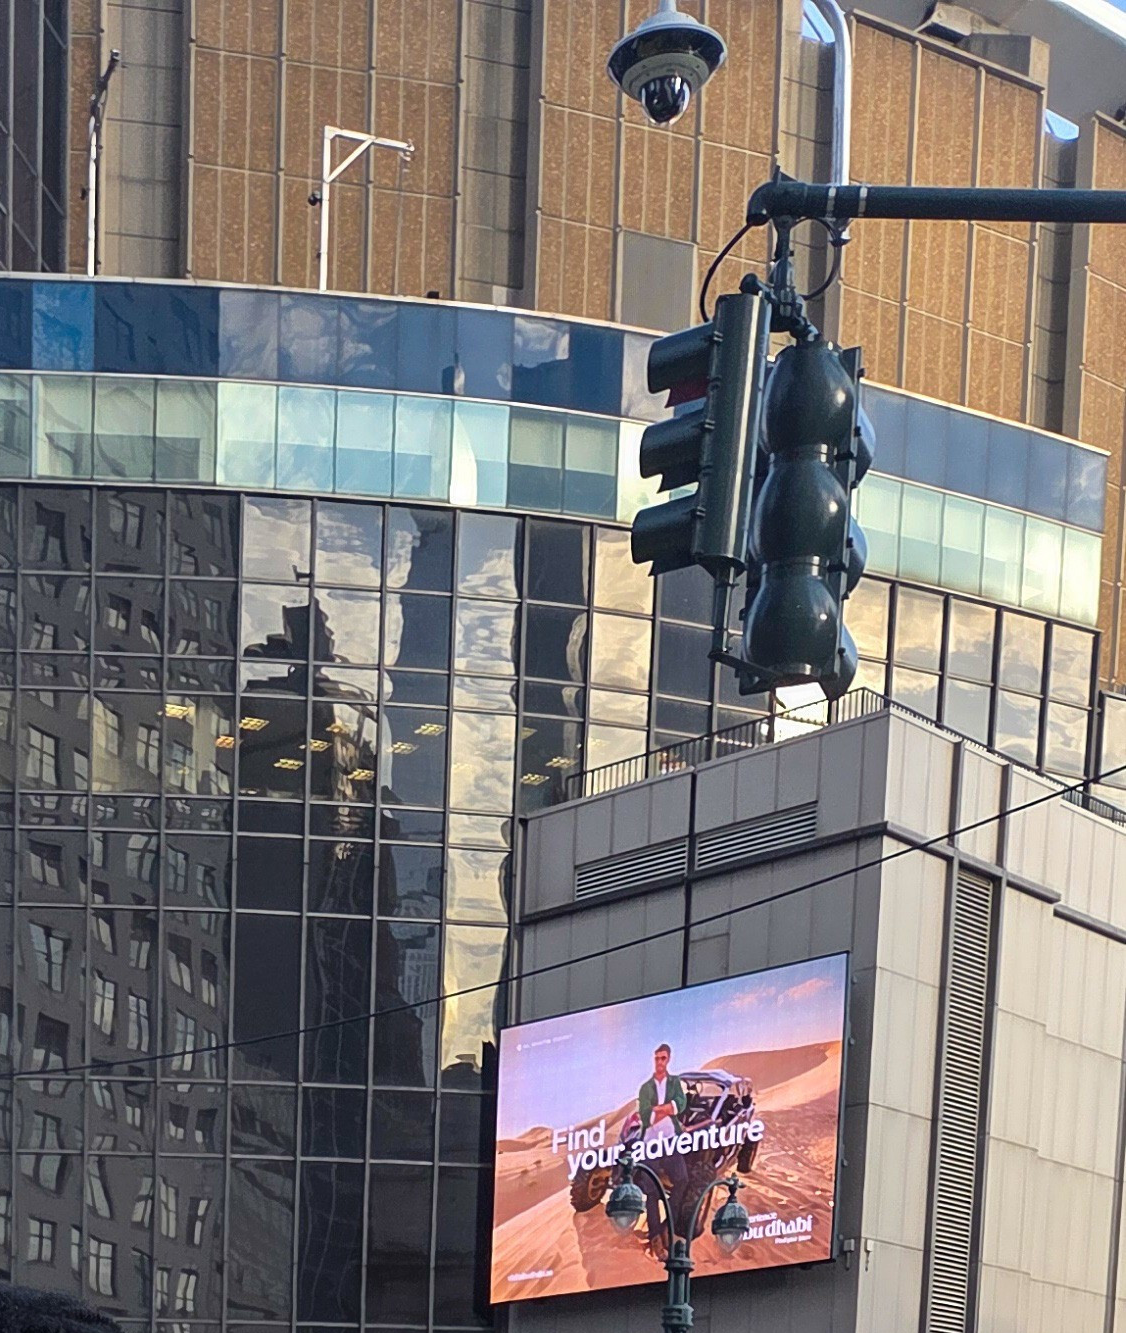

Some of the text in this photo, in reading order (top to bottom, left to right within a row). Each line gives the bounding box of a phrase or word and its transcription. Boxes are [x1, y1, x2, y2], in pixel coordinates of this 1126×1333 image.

[551, 1119, 606, 1154] Find
[567, 1118, 765, 1180] your adventure
[742, 1225, 764, 1241] bu
